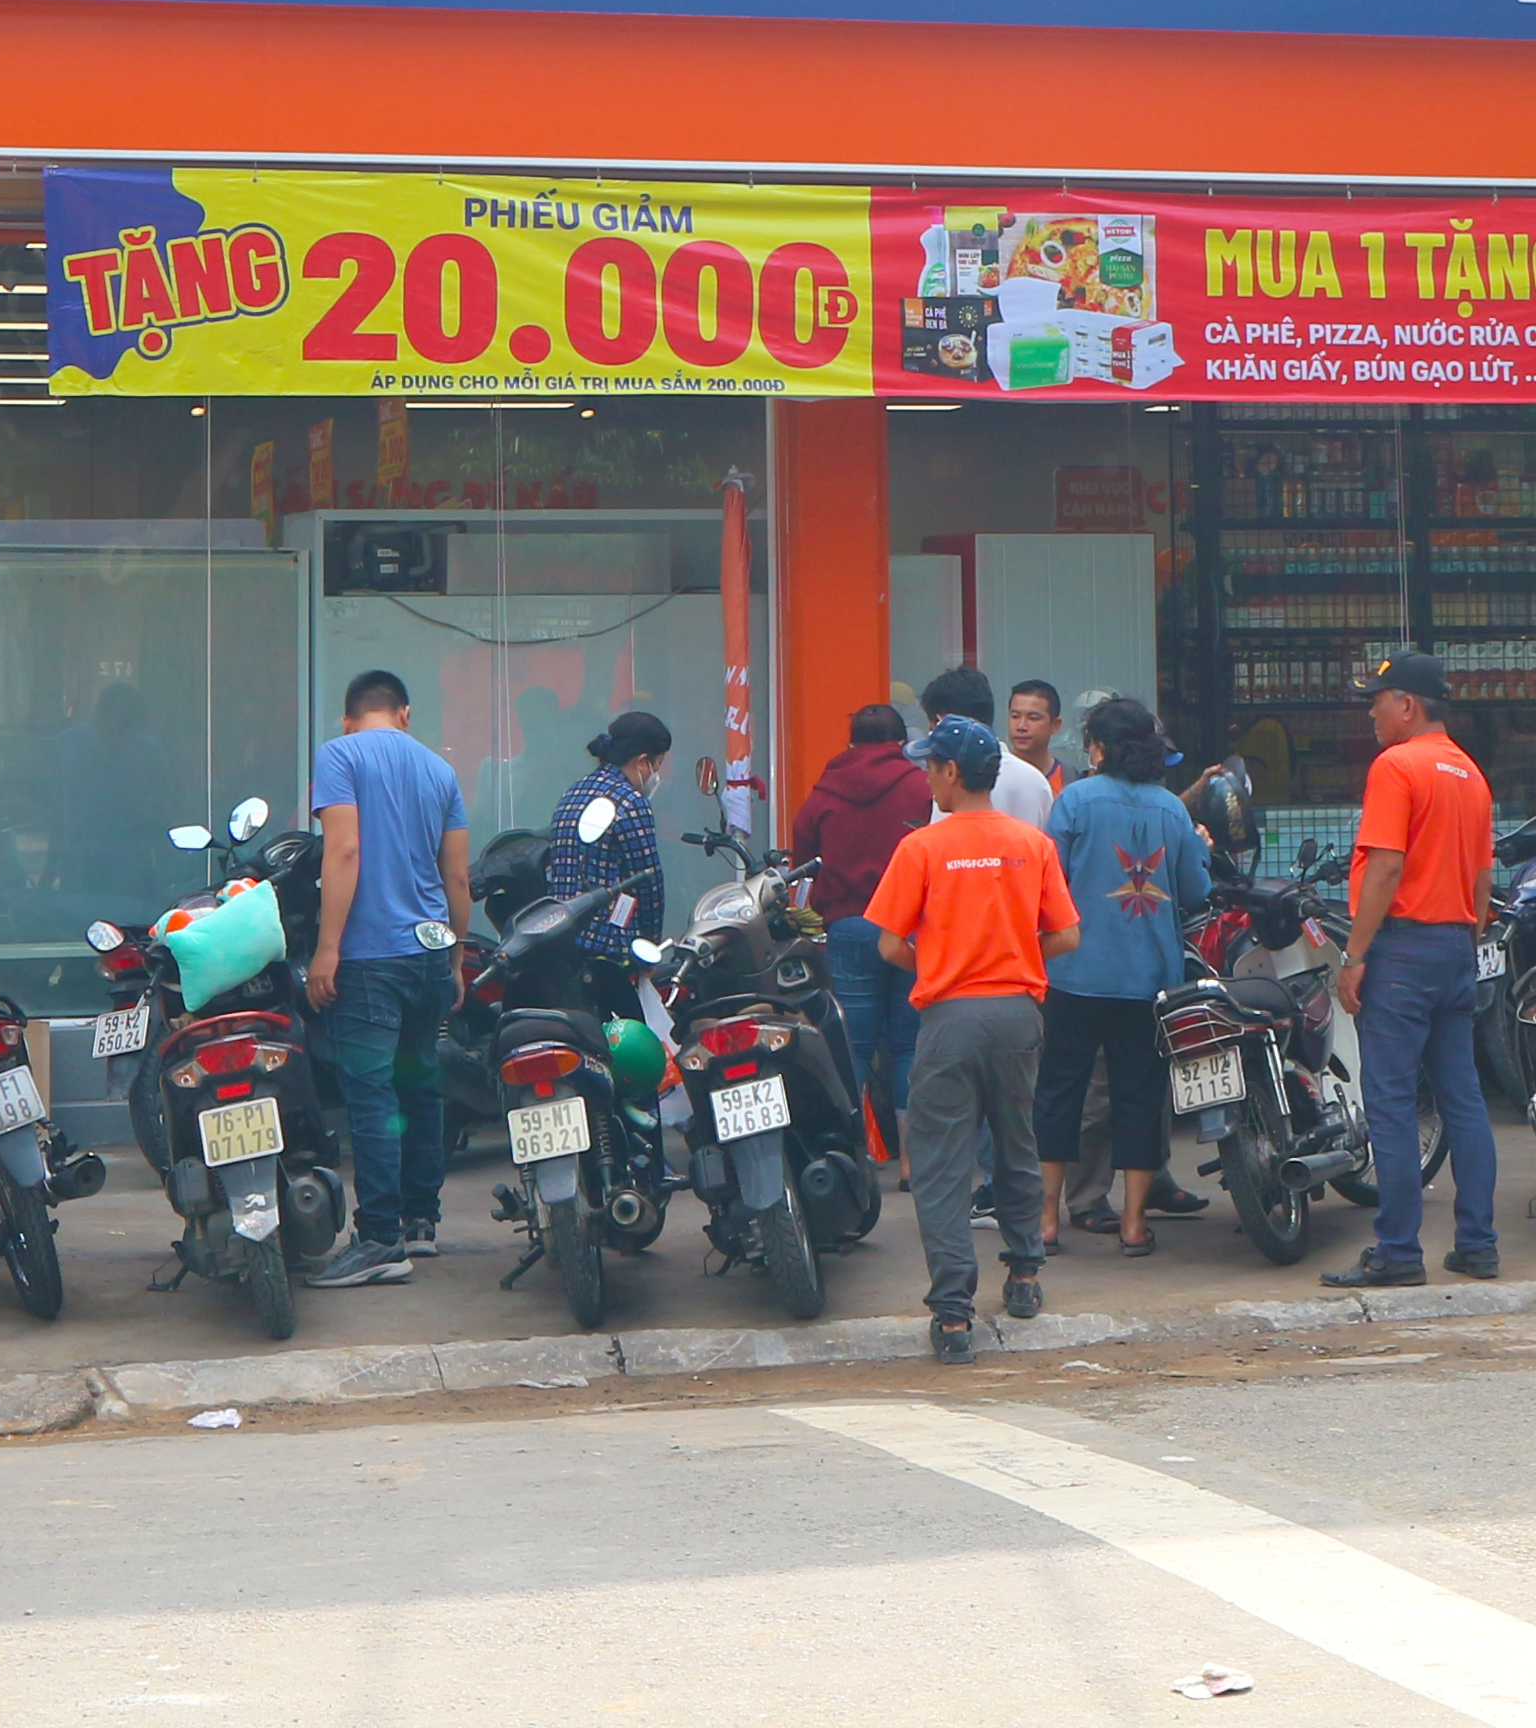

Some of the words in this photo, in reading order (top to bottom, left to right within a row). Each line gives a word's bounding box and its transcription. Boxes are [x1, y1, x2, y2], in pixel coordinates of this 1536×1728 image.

[464, 190, 580, 231] PHIẾU
[591, 194, 693, 234] GIẢM
[1205, 228, 1343, 299] MUA
[1359, 232, 1385, 300] 1
[66, 227, 282, 357] TẶNG
[1205, 321, 1241, 346] CÀ
[1246, 320, 1299, 350] PHÊ,
[1309, 325, 1388, 350] PIZZA,
[1394, 319, 1464, 347] NƯỚC
[1470, 320, 1521, 349] RỬA
[371, 370, 396, 389] ÁP
[401, 375, 454, 394] DỤNG
[459, 375, 498, 390] CHO
[504, 369, 540, 390] MỖI
[546, 371, 576, 390] GIÁ
[581, 376, 609, 394] TRỊ
[614, 377, 656, 391] MUA
[661, 371, 701, 391] SẮM
[706, 378, 786, 392] 200.000Đ
[1206, 357, 1279, 383] KHĂN
[1284, 354, 1348, 387] GIẤY,
[1354, 357, 1405, 383] BÚN
[1410, 360, 1464, 388] GẠO
[1468, 355, 1518, 387] LỨT,
[97, 1032, 141, 1054] 650.24
[720, 1081, 775, 1113] 59-K2
[1184, 1078, 1233, 1108] 2115
[212, 1106, 267, 1135] 76-P1
[520, 1104, 573, 1133] 59-N1
[718, 1104, 785, 1139] 346.83
[209, 1128, 279, 1162] 071.79
[516, 1127, 583, 1159] 963.21
